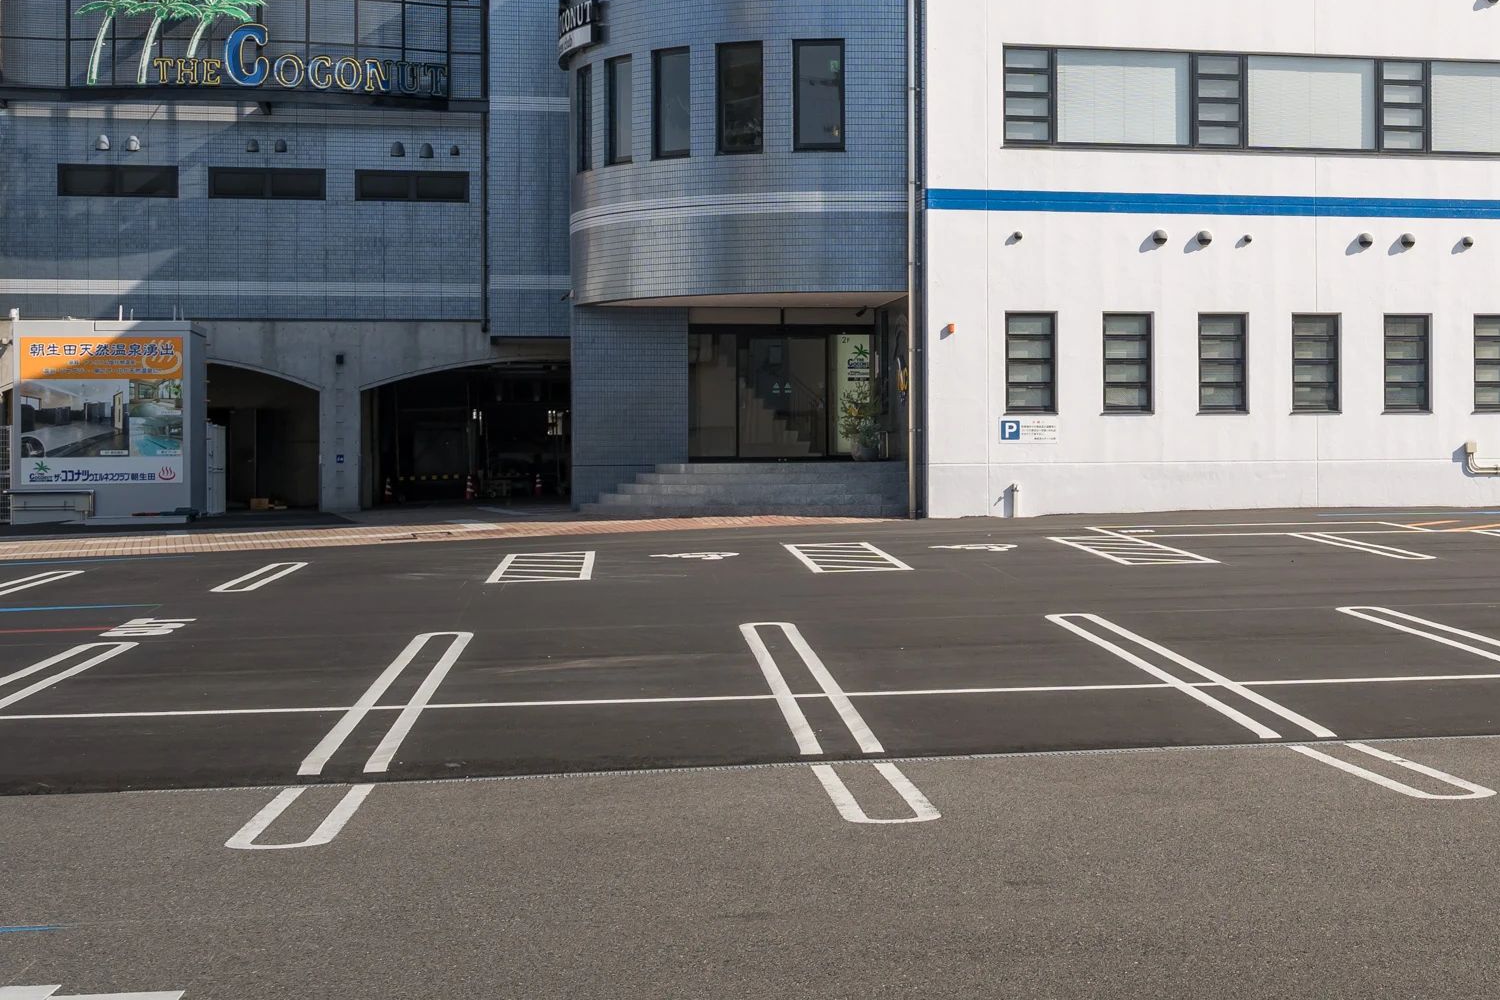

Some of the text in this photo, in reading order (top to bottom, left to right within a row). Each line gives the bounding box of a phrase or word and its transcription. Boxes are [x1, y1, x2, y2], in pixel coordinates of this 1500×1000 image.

[153, 23, 447, 96] THE COCONUT
[29, 343, 175, 357] 朝生田天然温泉湧出
[1005, 422, 1017, 439] P
